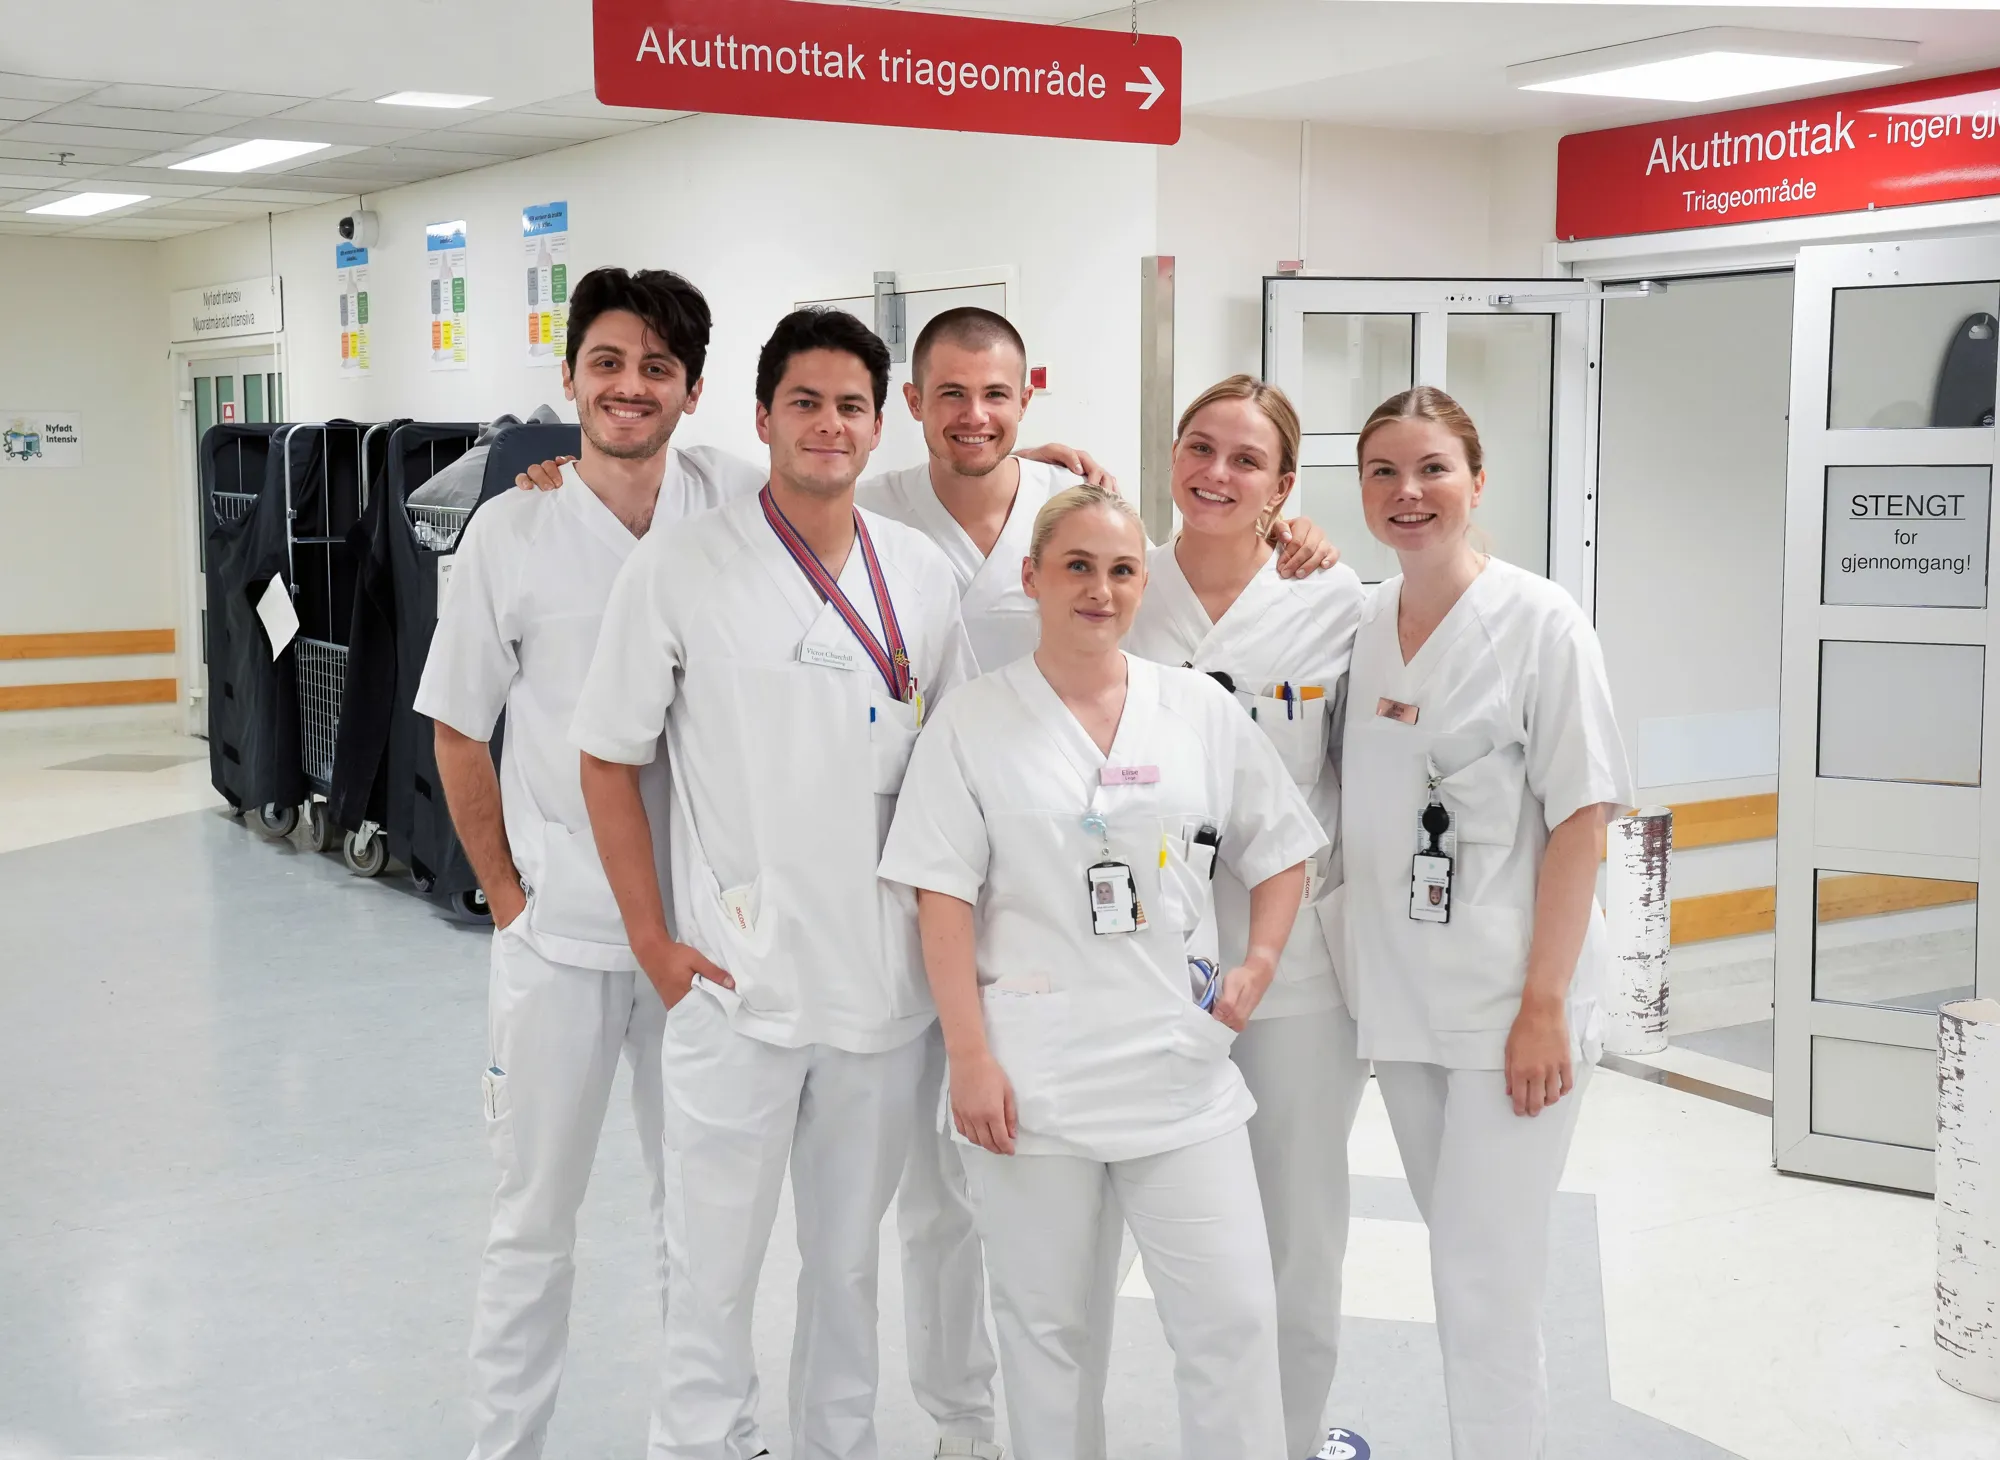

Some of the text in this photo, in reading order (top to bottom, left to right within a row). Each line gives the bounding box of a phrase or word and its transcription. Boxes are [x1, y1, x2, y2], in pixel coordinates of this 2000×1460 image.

[636, 26, 1107, 99] Akuttmottak triageområde
[1645, 111, 1856, 176] Akuttmottak
[1887, 113, 1961, 148] ingen
[1971, 101, 2000, 140] gj
[1682, 177, 1817, 214] Triageområde
[45, 424, 73, 434] Nyfødt
[46, 435, 78, 443] Intensiv
[1851, 494, 1965, 516] STENGT
[1894, 528, 1918, 545] for
[1841, 554, 1971, 575] gjennomgang!
[735, 906, 747, 929] ascom
